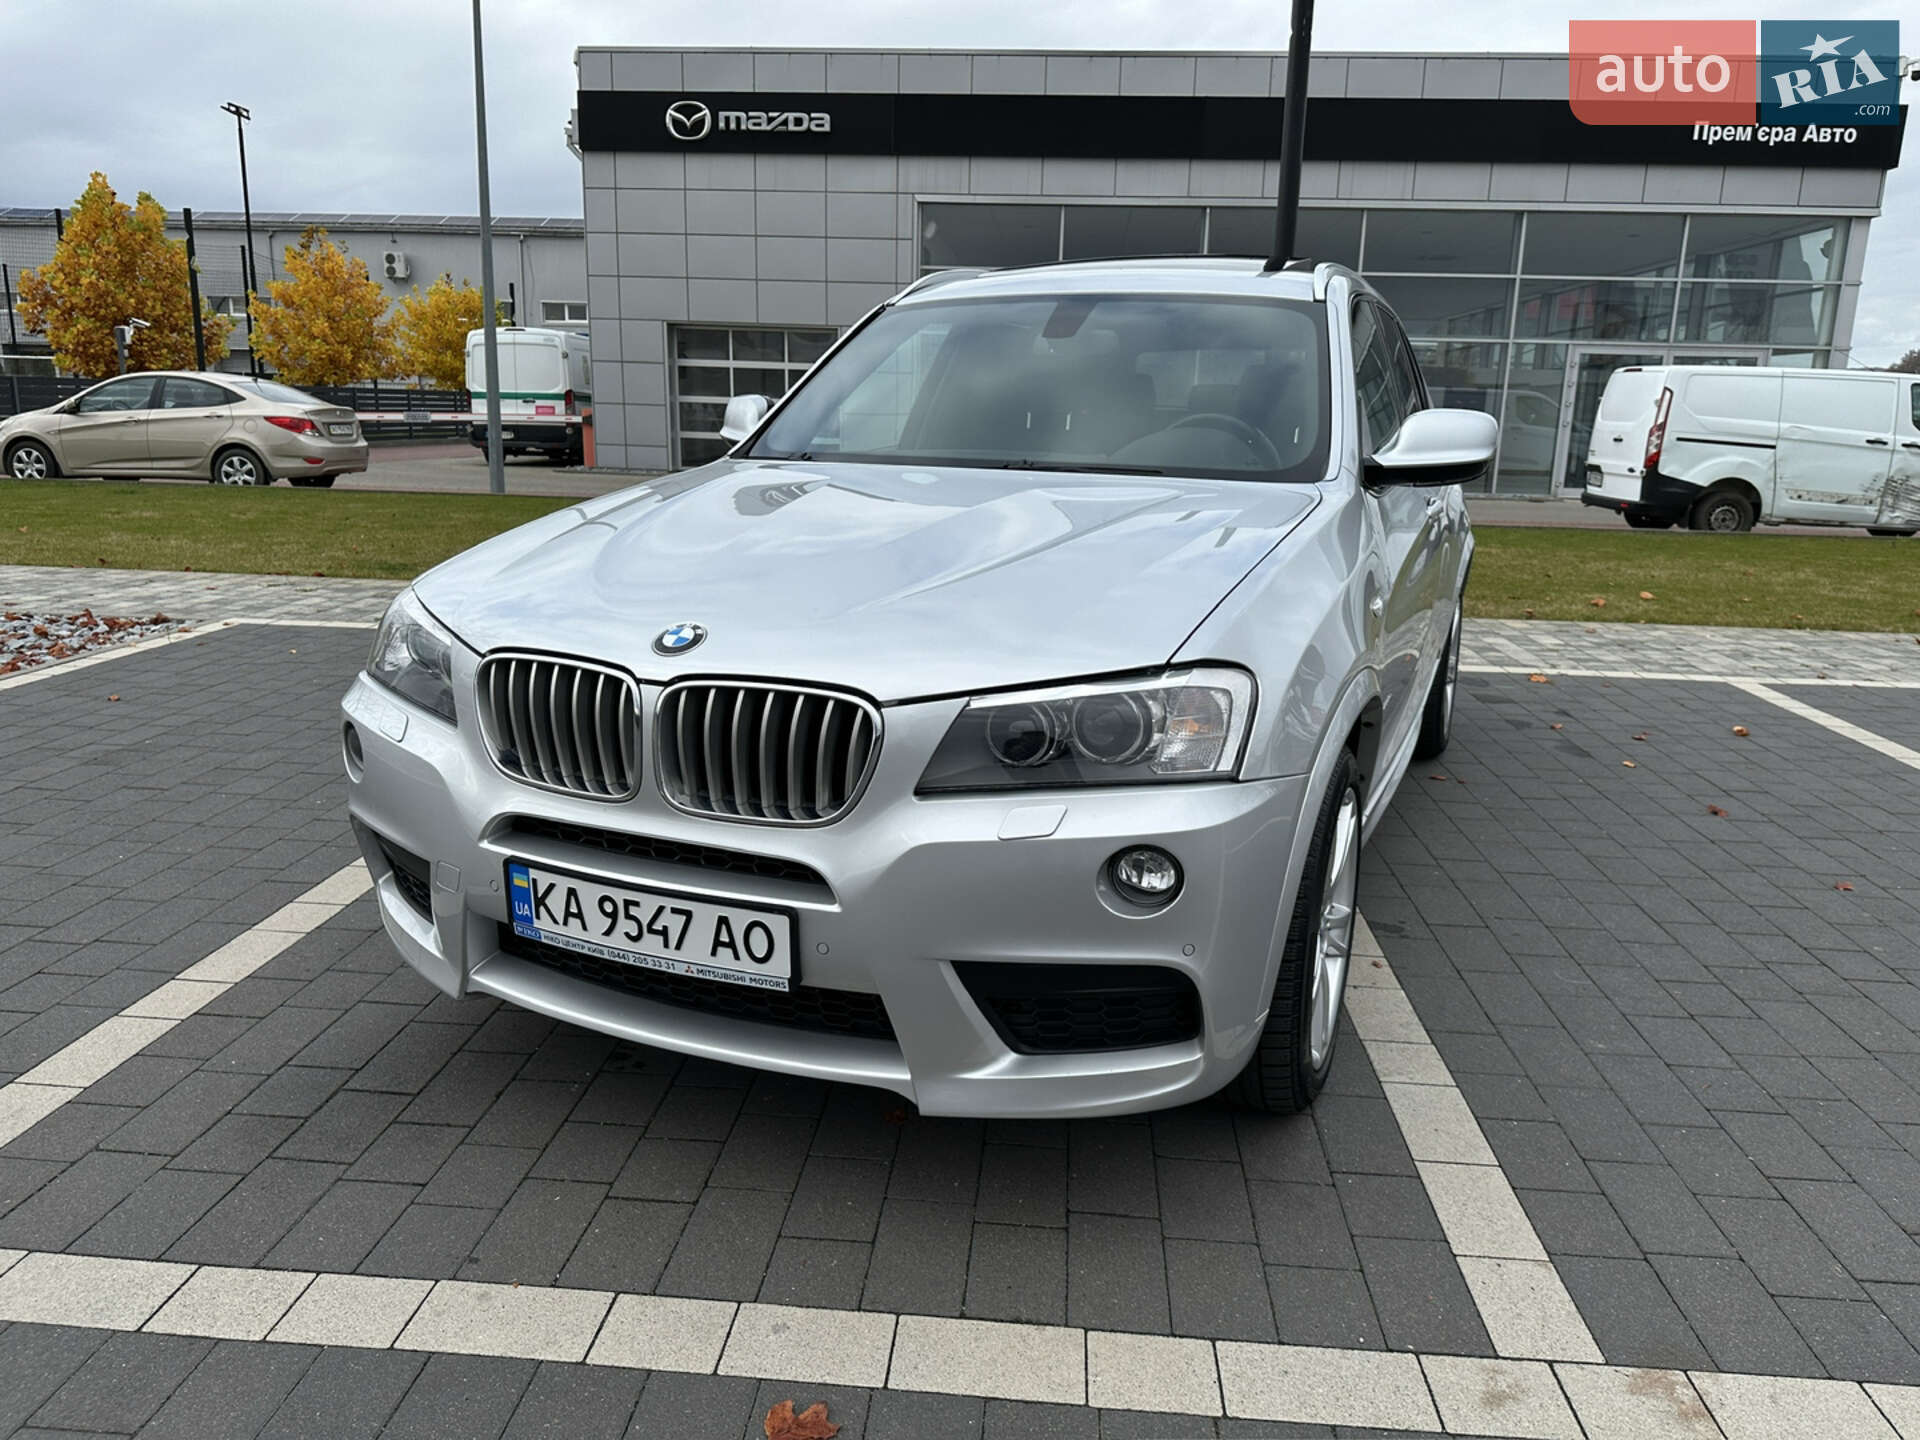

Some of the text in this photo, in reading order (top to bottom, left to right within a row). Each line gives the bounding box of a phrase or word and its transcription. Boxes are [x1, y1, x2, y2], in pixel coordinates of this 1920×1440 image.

[1802, 122, 1857, 143] Авто
[514, 900, 532, 918] UA
[531, 877, 775, 964] KA 9547 AO
[607, 949, 630, 962] (044)
[632, 955, 649, 965] 205
[650, 958, 663, 968] 33
[664, 961, 676, 971] 31
[696, 967, 787, 989] MITSUBISHI MOTORS
